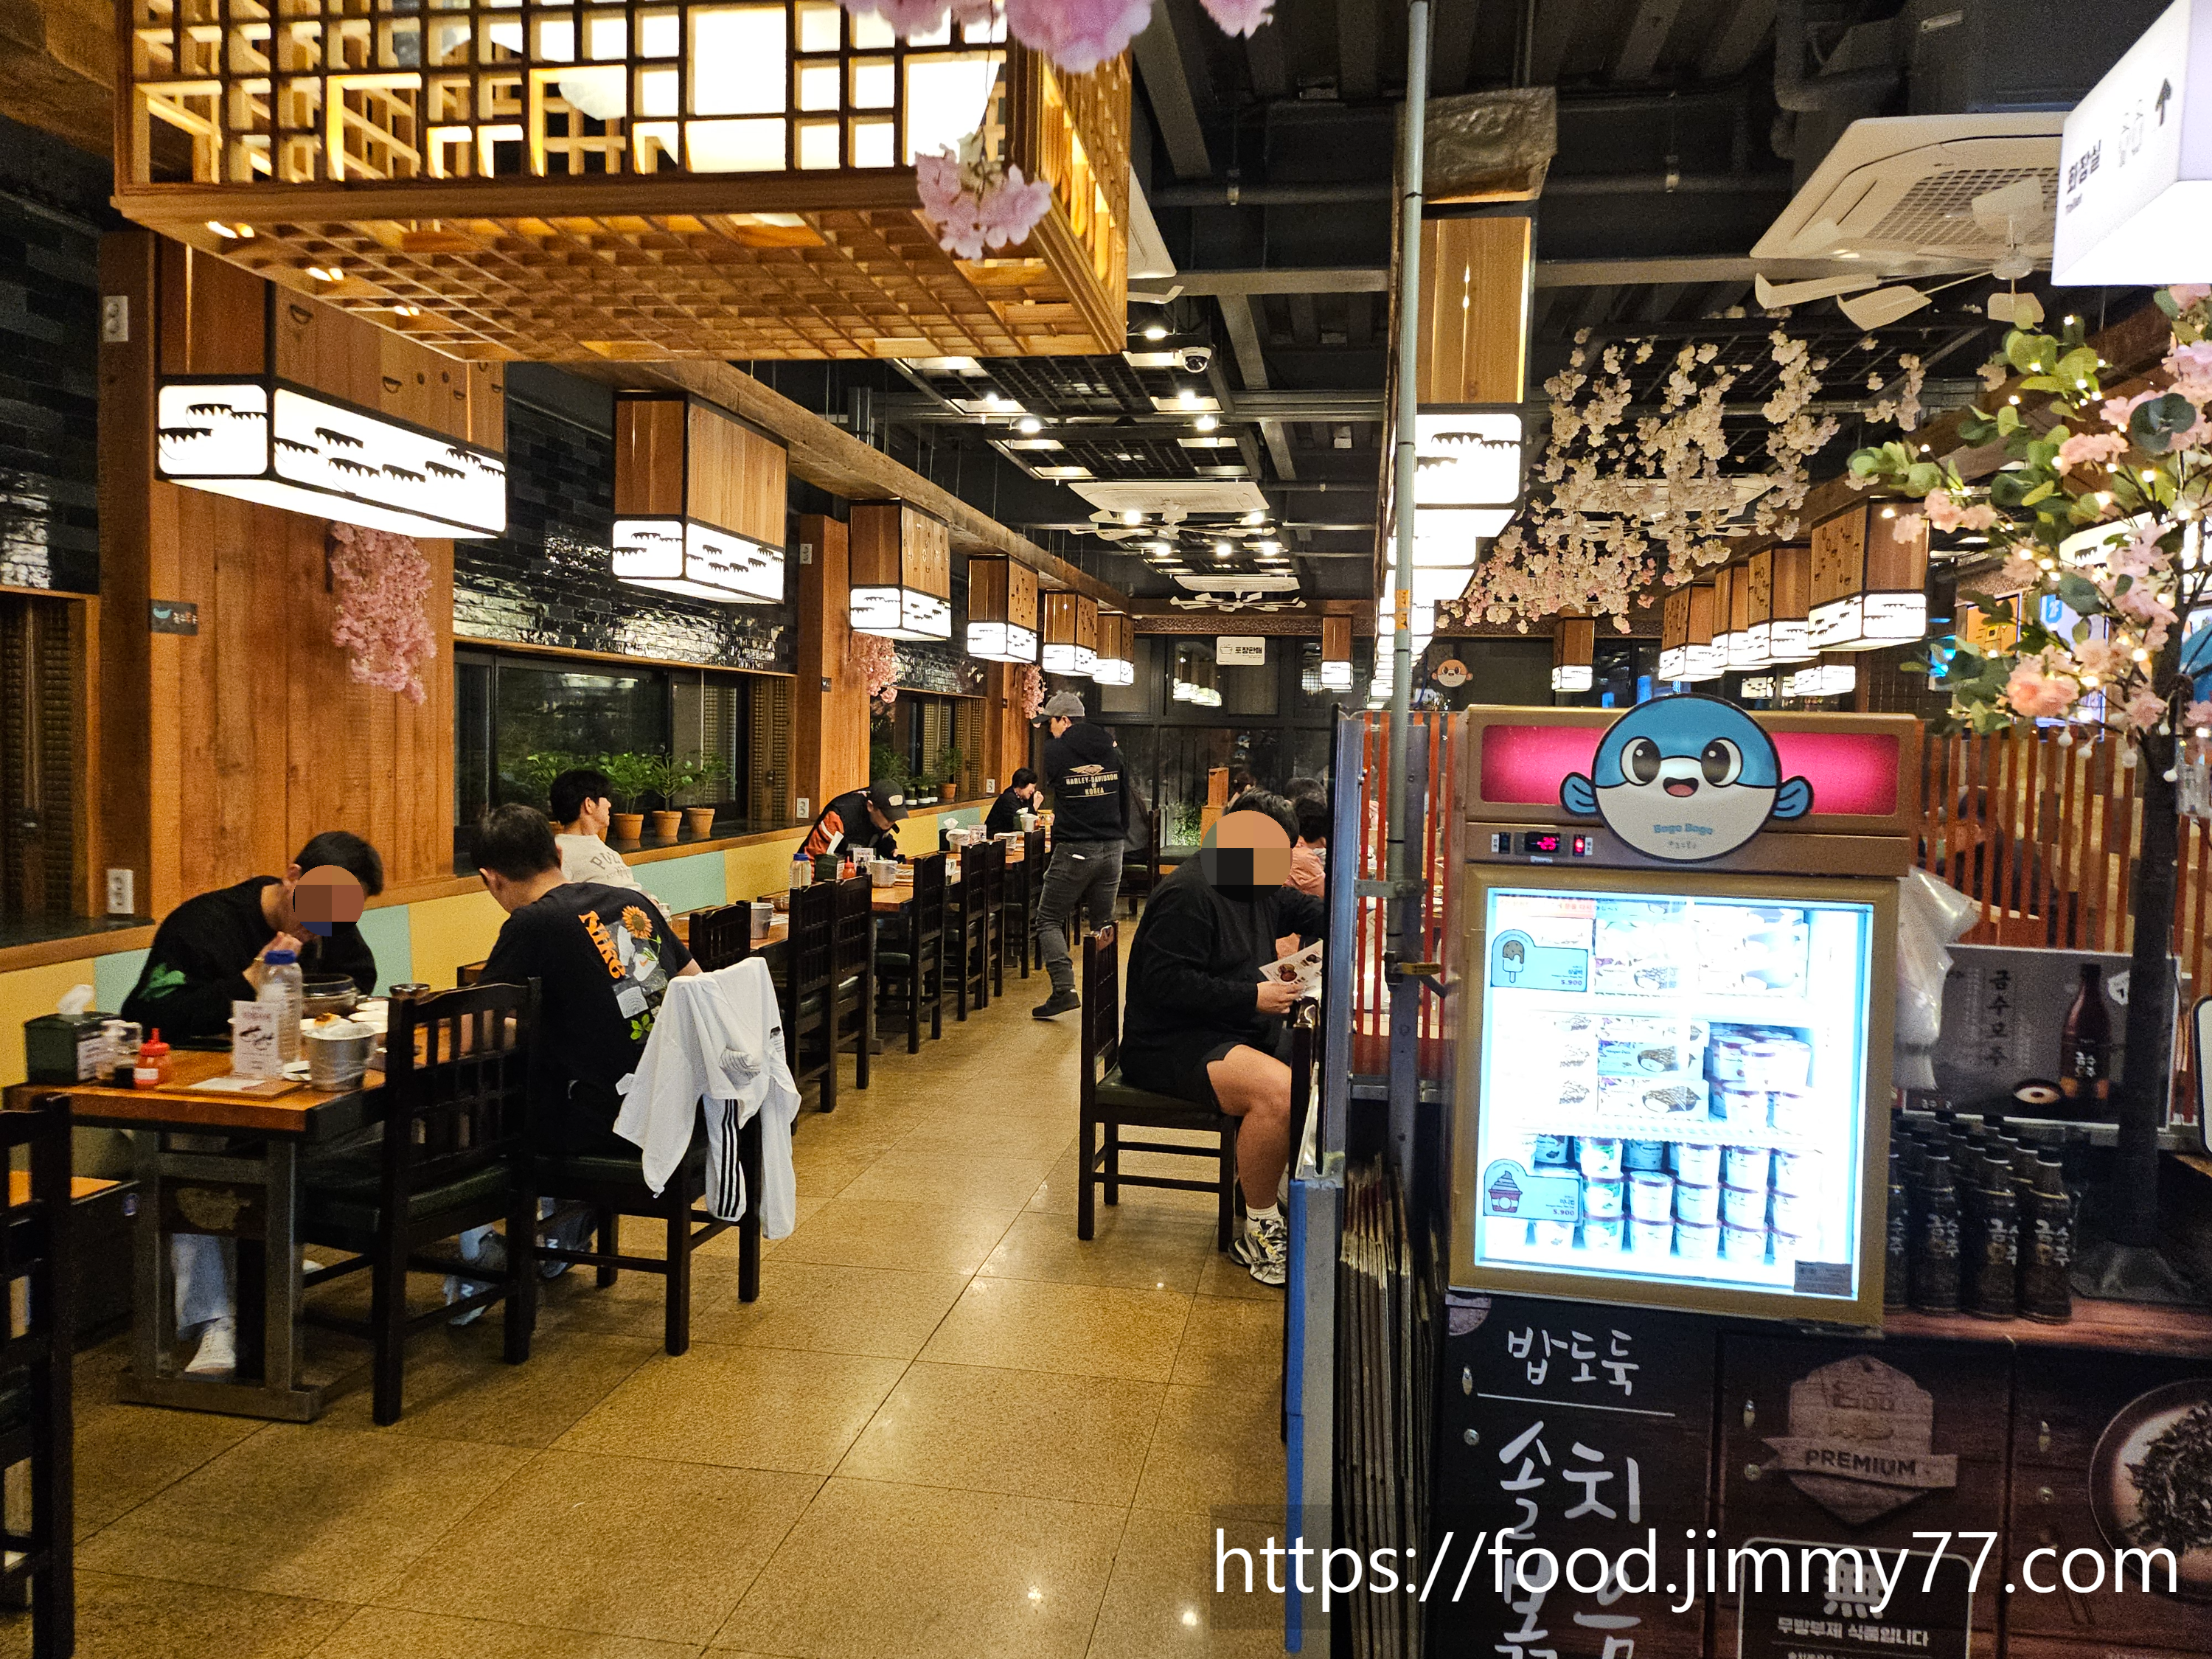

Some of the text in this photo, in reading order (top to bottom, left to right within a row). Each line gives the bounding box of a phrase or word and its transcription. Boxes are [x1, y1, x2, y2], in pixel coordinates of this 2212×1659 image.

[1066, 774, 1118, 785] HARLEY-DAVIDSON
[1508, 1326, 1640, 1396] 밥도둑
[1806, 1448, 1916, 1475] PREMIUM
[1778, 1617, 1930, 1647] 무방부제 식품입니다
